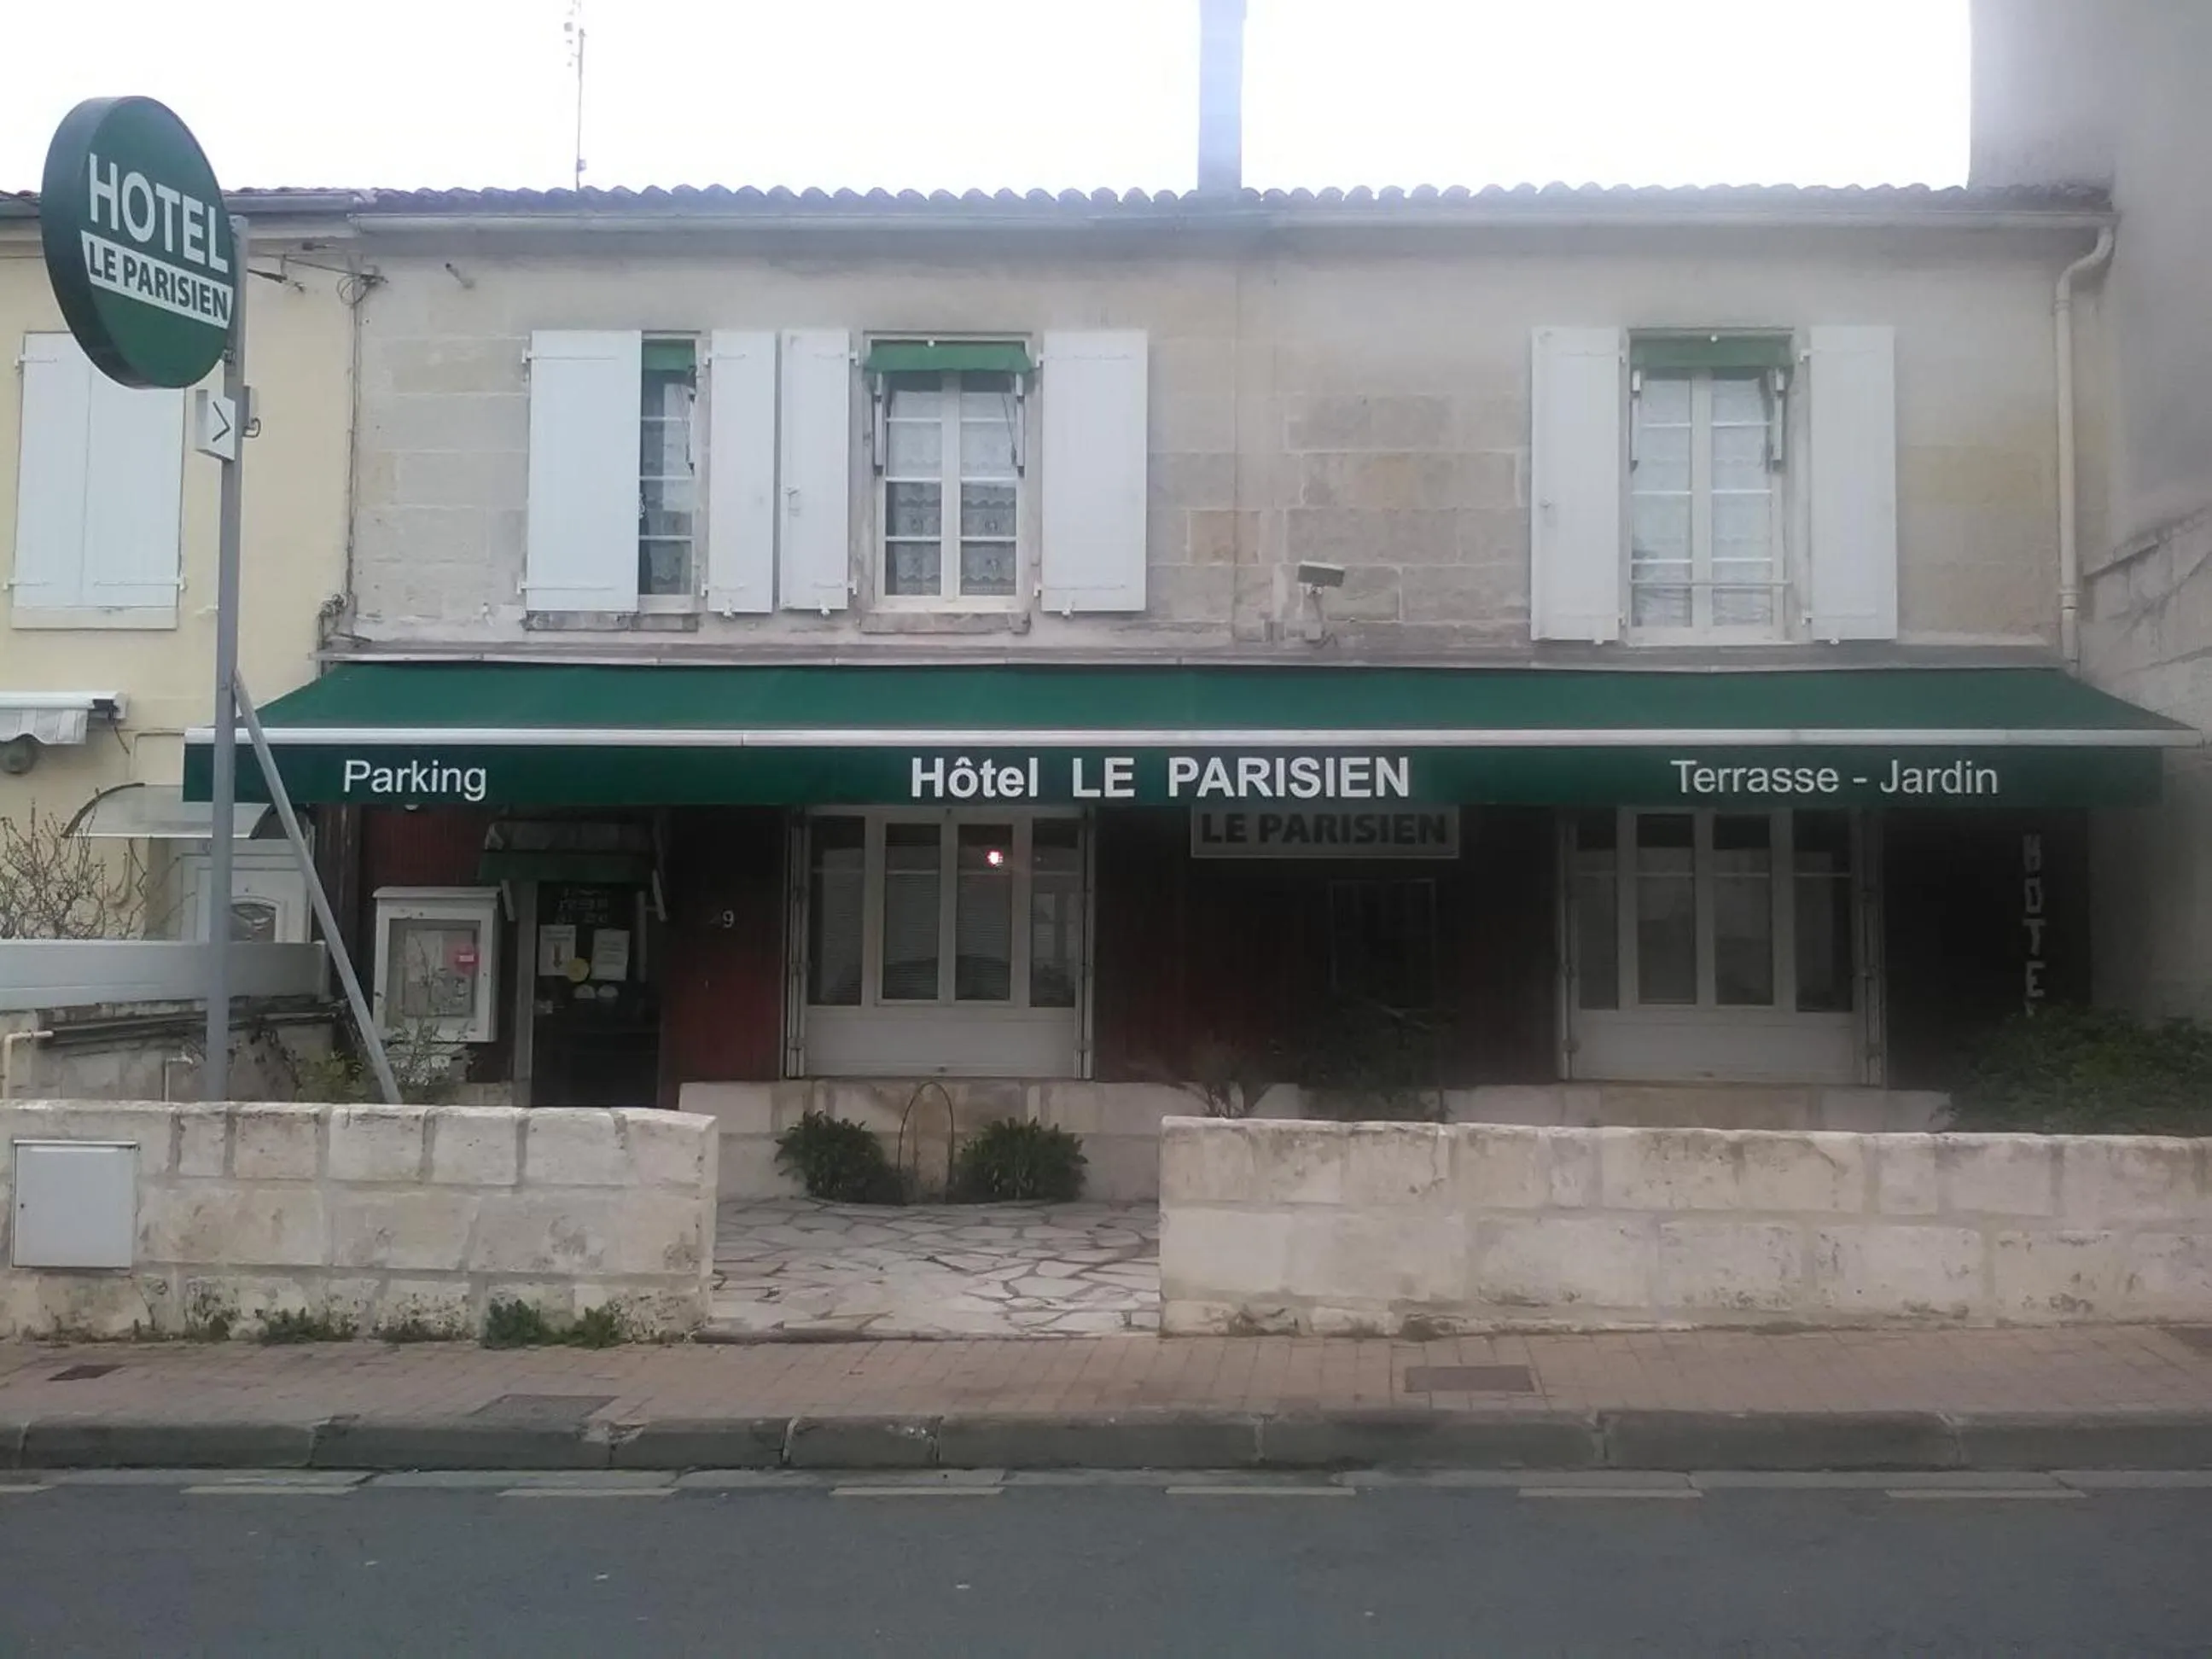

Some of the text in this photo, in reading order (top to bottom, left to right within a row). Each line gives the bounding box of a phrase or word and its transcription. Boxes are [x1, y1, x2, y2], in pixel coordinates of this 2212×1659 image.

[89, 152, 229, 274] HOTEL
[89, 241, 229, 321] LE PARISIEN
[342, 760, 487, 801] Parking
[911, 756, 1410, 799] Hôtel LE PARISIEN
[1670, 760, 1839, 795] Terrasse
[1879, 760, 2000, 795] Jardin
[1201, 812, 1447, 845] LE PARISIEN
